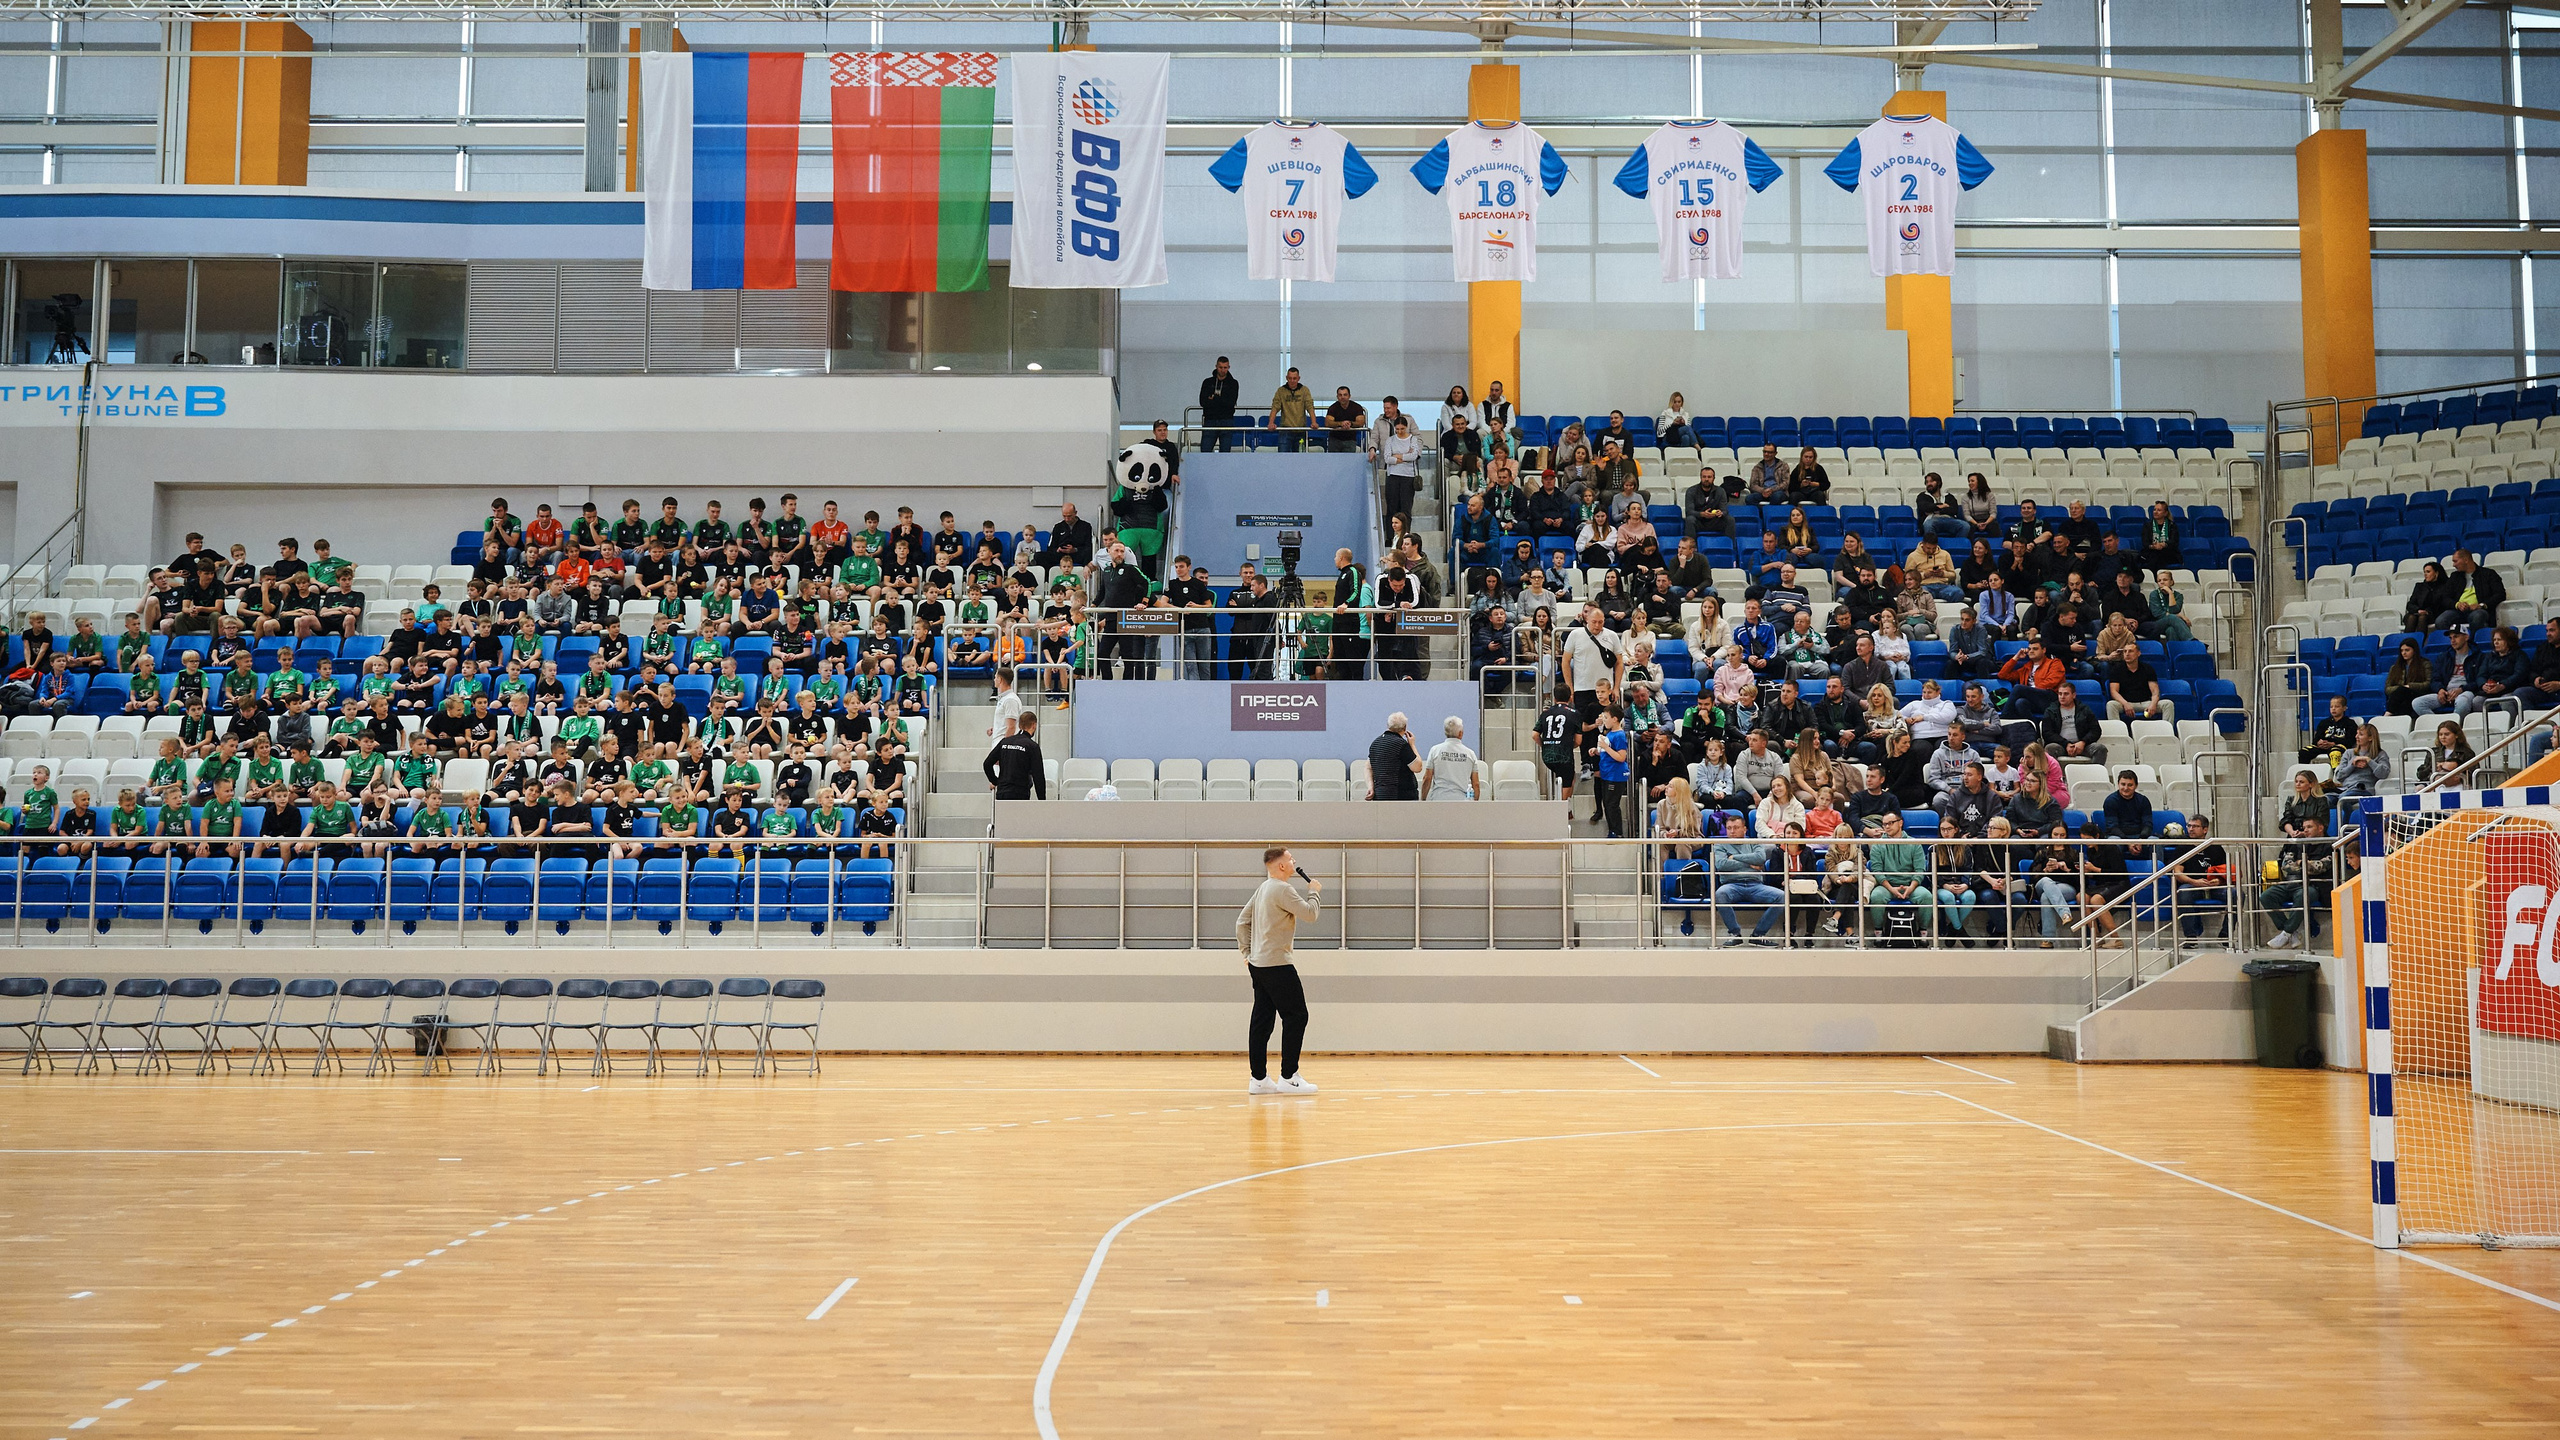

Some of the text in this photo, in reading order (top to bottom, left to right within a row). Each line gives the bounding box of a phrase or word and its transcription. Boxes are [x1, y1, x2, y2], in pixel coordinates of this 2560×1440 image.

[1055, 74, 1067, 263] Всероссийская федерация волейбола
[1267, 160, 1322, 175] ШЕВЦОВ
[1656, 161, 1738, 186] СВИРИДЕНКО
[1870, 155, 1947, 179] ШАРОВАРОВ
[1071, 128, 1121, 262] ВФВ
[1285, 179, 1305, 206] 7
[1477, 180, 1517, 207] 18
[1678, 178, 1715, 207] 15
[1899, 174, 1919, 201] 2
[1270, 209, 1296, 219] СЕУЛ
[1459, 211, 1516, 221] БАРСЕЛОНА
[1675, 208, 1722, 219] СЕУЛ 1988
[1887, 204, 1933, 214] СЕУЛ 1988
[185, 385, 227, 417] B
[1444, 614, 1454, 622] D
[1240, 695, 1319, 707] ПРЕССА
[1256, 712, 1300, 721] PRESS
[1545, 714, 1566, 739] 13
